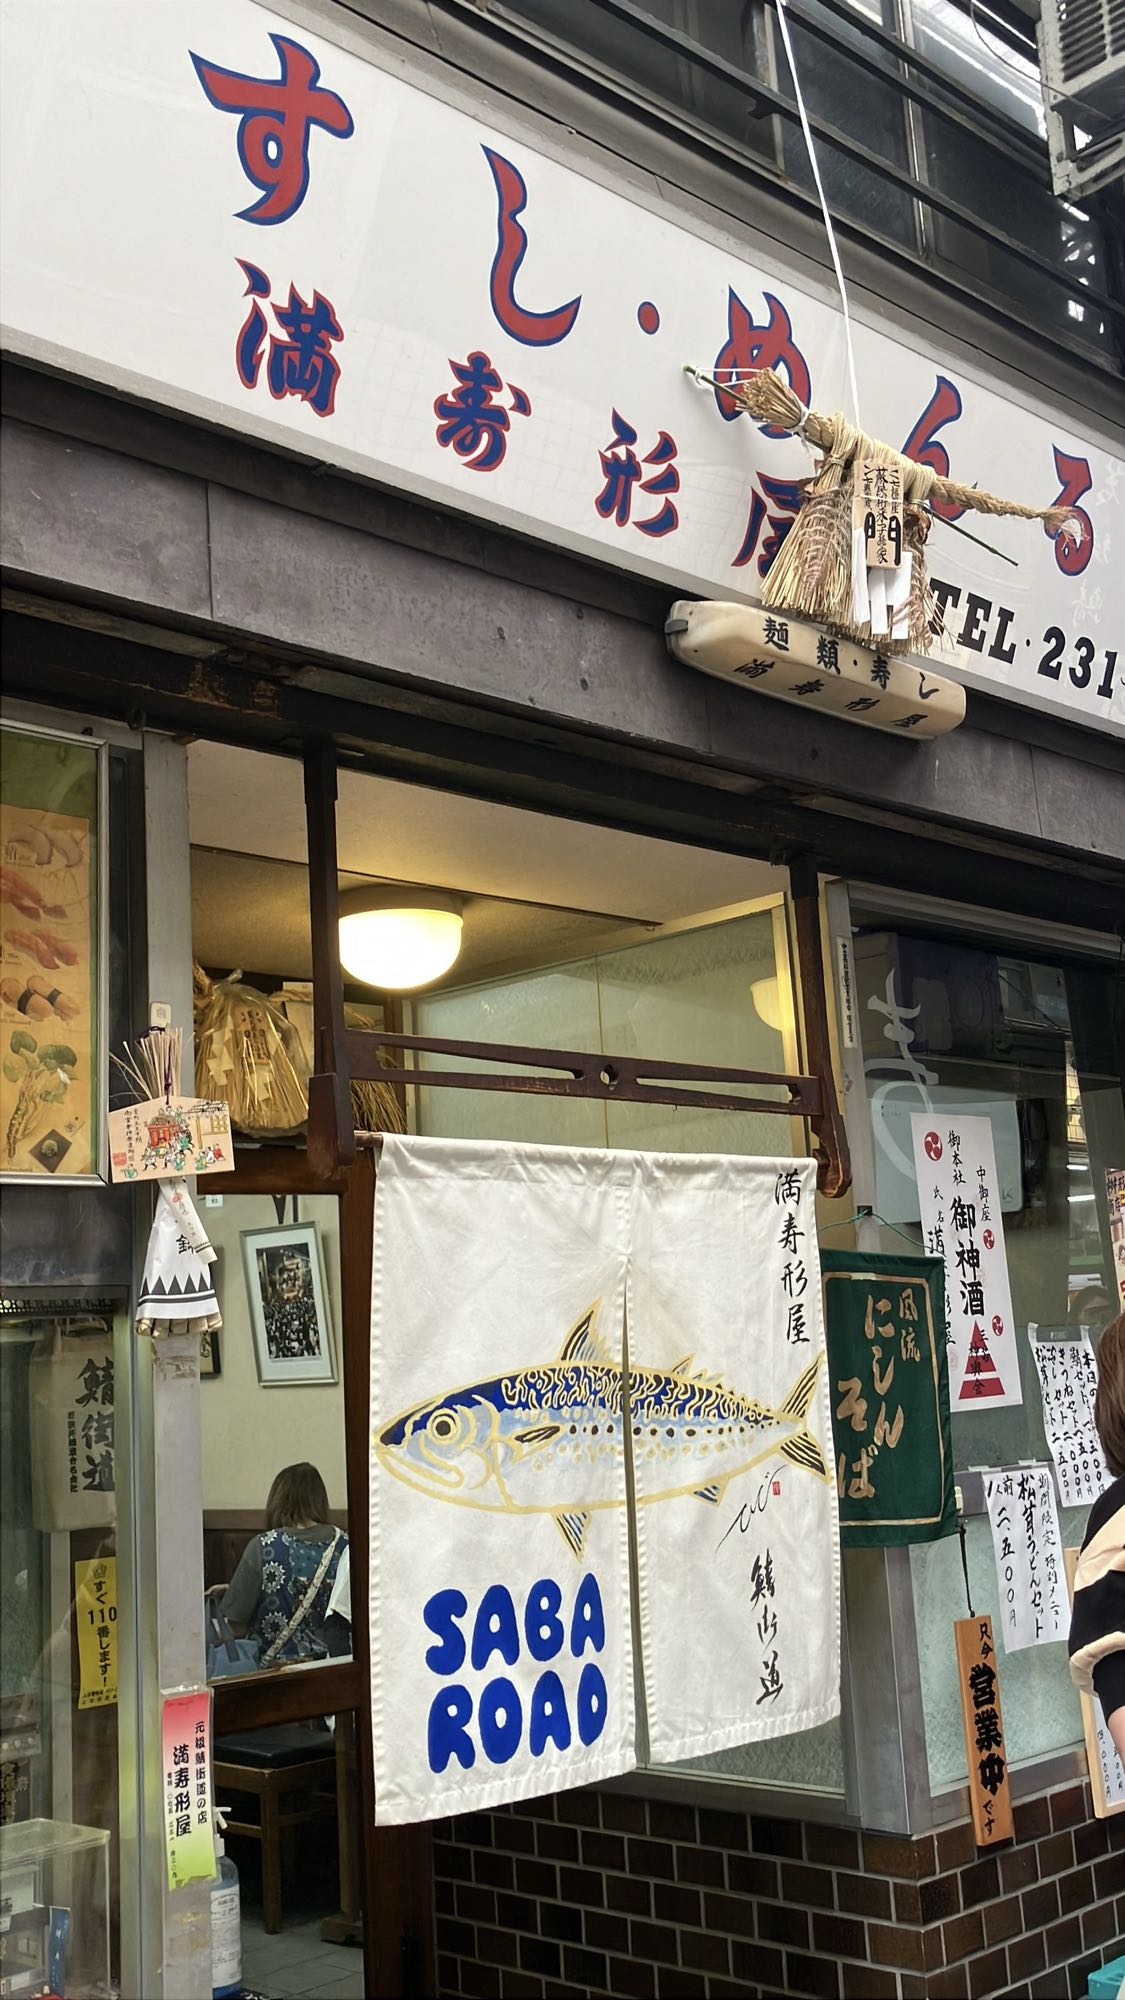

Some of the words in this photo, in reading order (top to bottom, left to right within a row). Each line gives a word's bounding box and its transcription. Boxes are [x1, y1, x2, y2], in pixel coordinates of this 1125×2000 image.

[948, 1130, 966, 1186] 御本社
[976, 1165, 991, 1222] 中御座
[774, 1168, 810, 1344] 満寿形屋
[950, 1198, 984, 1316] 御神酒
[864, 1294, 904, 1448] にしん
[836, 1376, 879, 1499] そば
[423, 1572, 606, 1676] SABA
[749, 1547, 784, 1706] 鯖街道
[427, 1662, 608, 1774] ROAD
[172, 1743, 192, 1838] 満寿形屋
